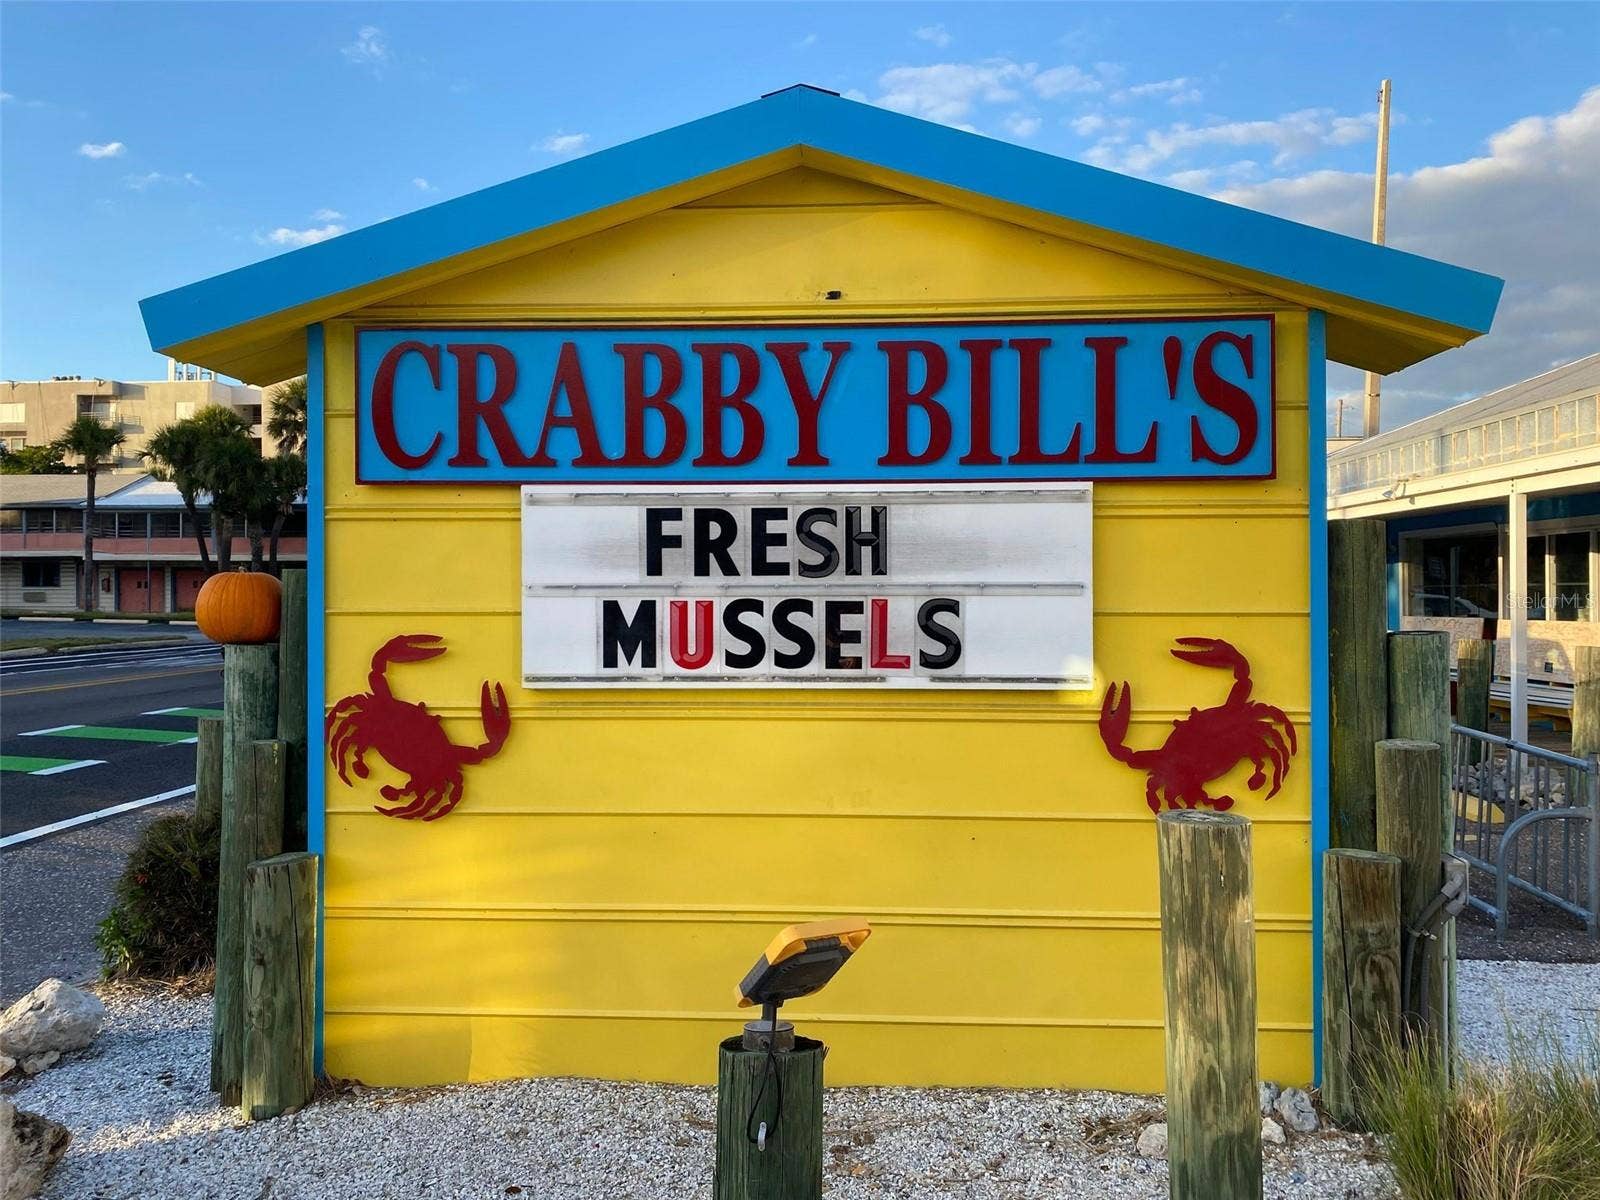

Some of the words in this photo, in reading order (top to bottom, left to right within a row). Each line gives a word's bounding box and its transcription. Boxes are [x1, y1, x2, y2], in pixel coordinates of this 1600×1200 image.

[372, 341, 851, 469] CRABBY
[878, 331, 1259, 466] BILL'S
[646, 506, 888, 578] FRESH
[602, 598, 962, 670] MUSSELS
